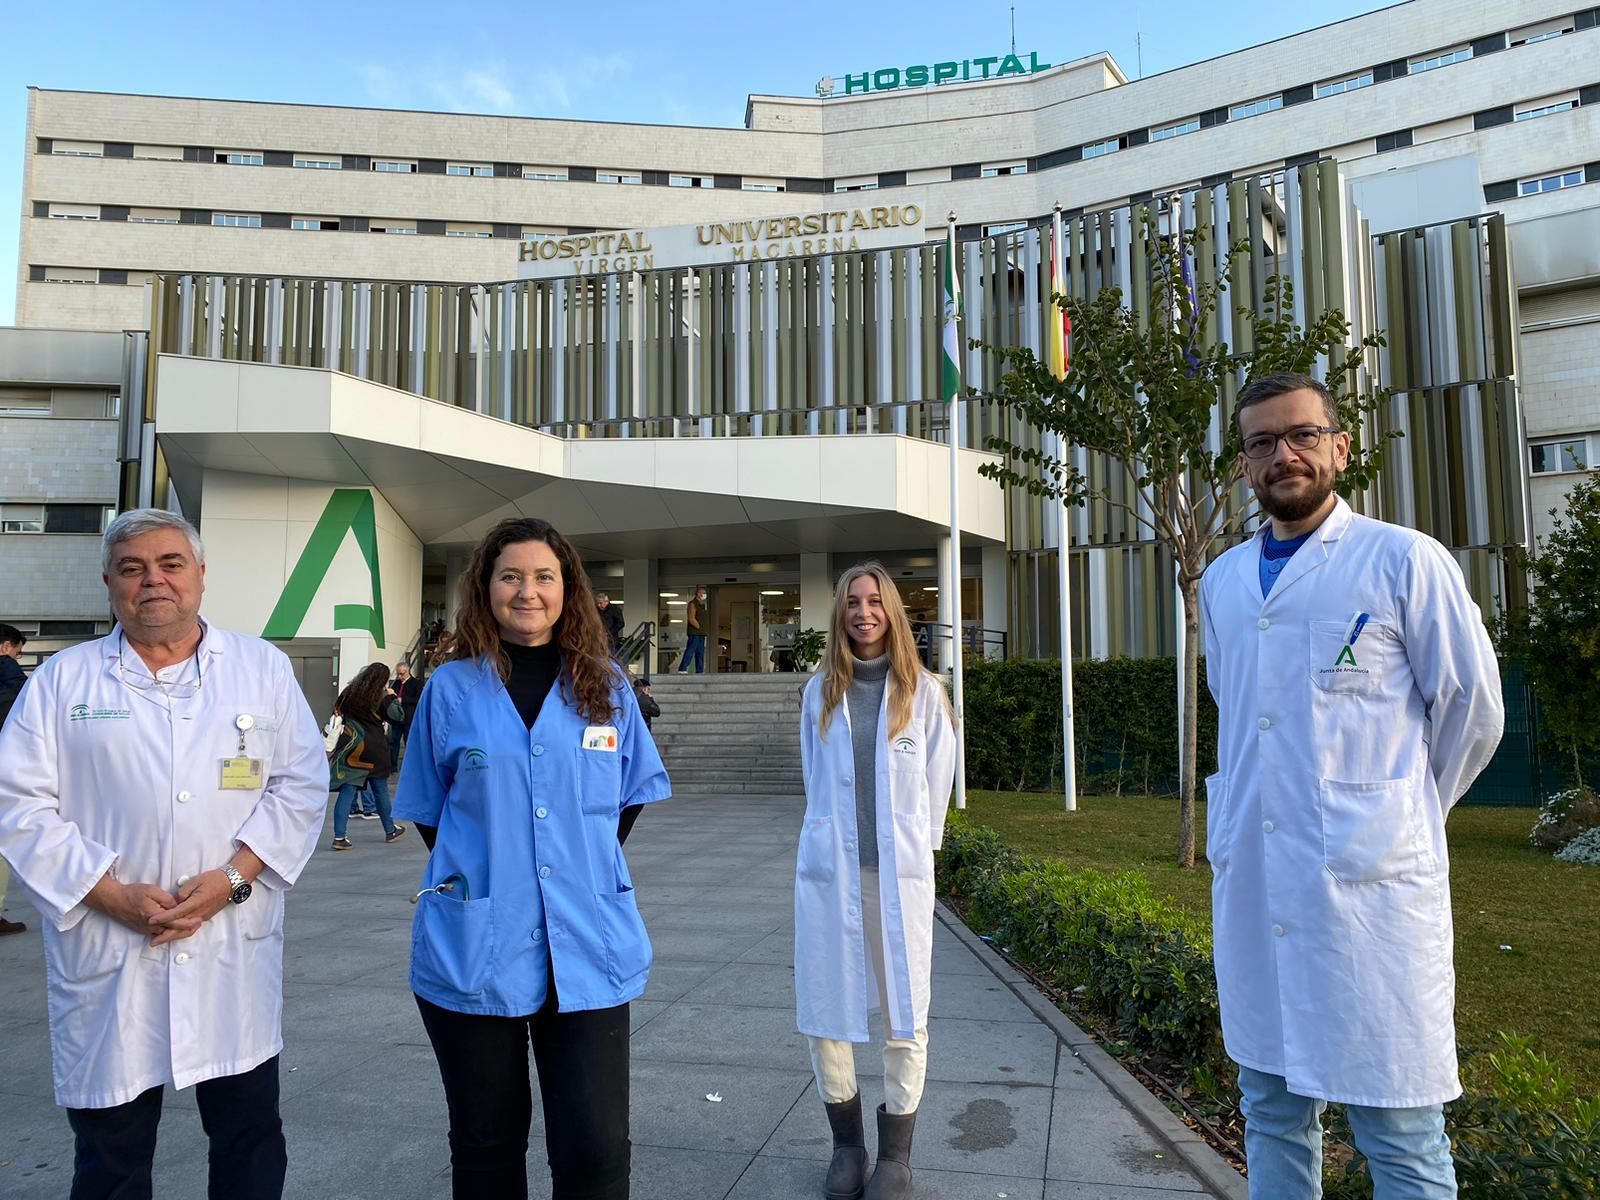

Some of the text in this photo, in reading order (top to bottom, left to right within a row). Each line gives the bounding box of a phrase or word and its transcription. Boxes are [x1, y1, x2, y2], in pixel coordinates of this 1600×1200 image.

[845, 51, 1052, 94] HOSPITAL
[518, 204, 922, 262] HOSPITAL UNIVERSITARIO
[573, 235, 860, 276] VIRGEN MACARENA
